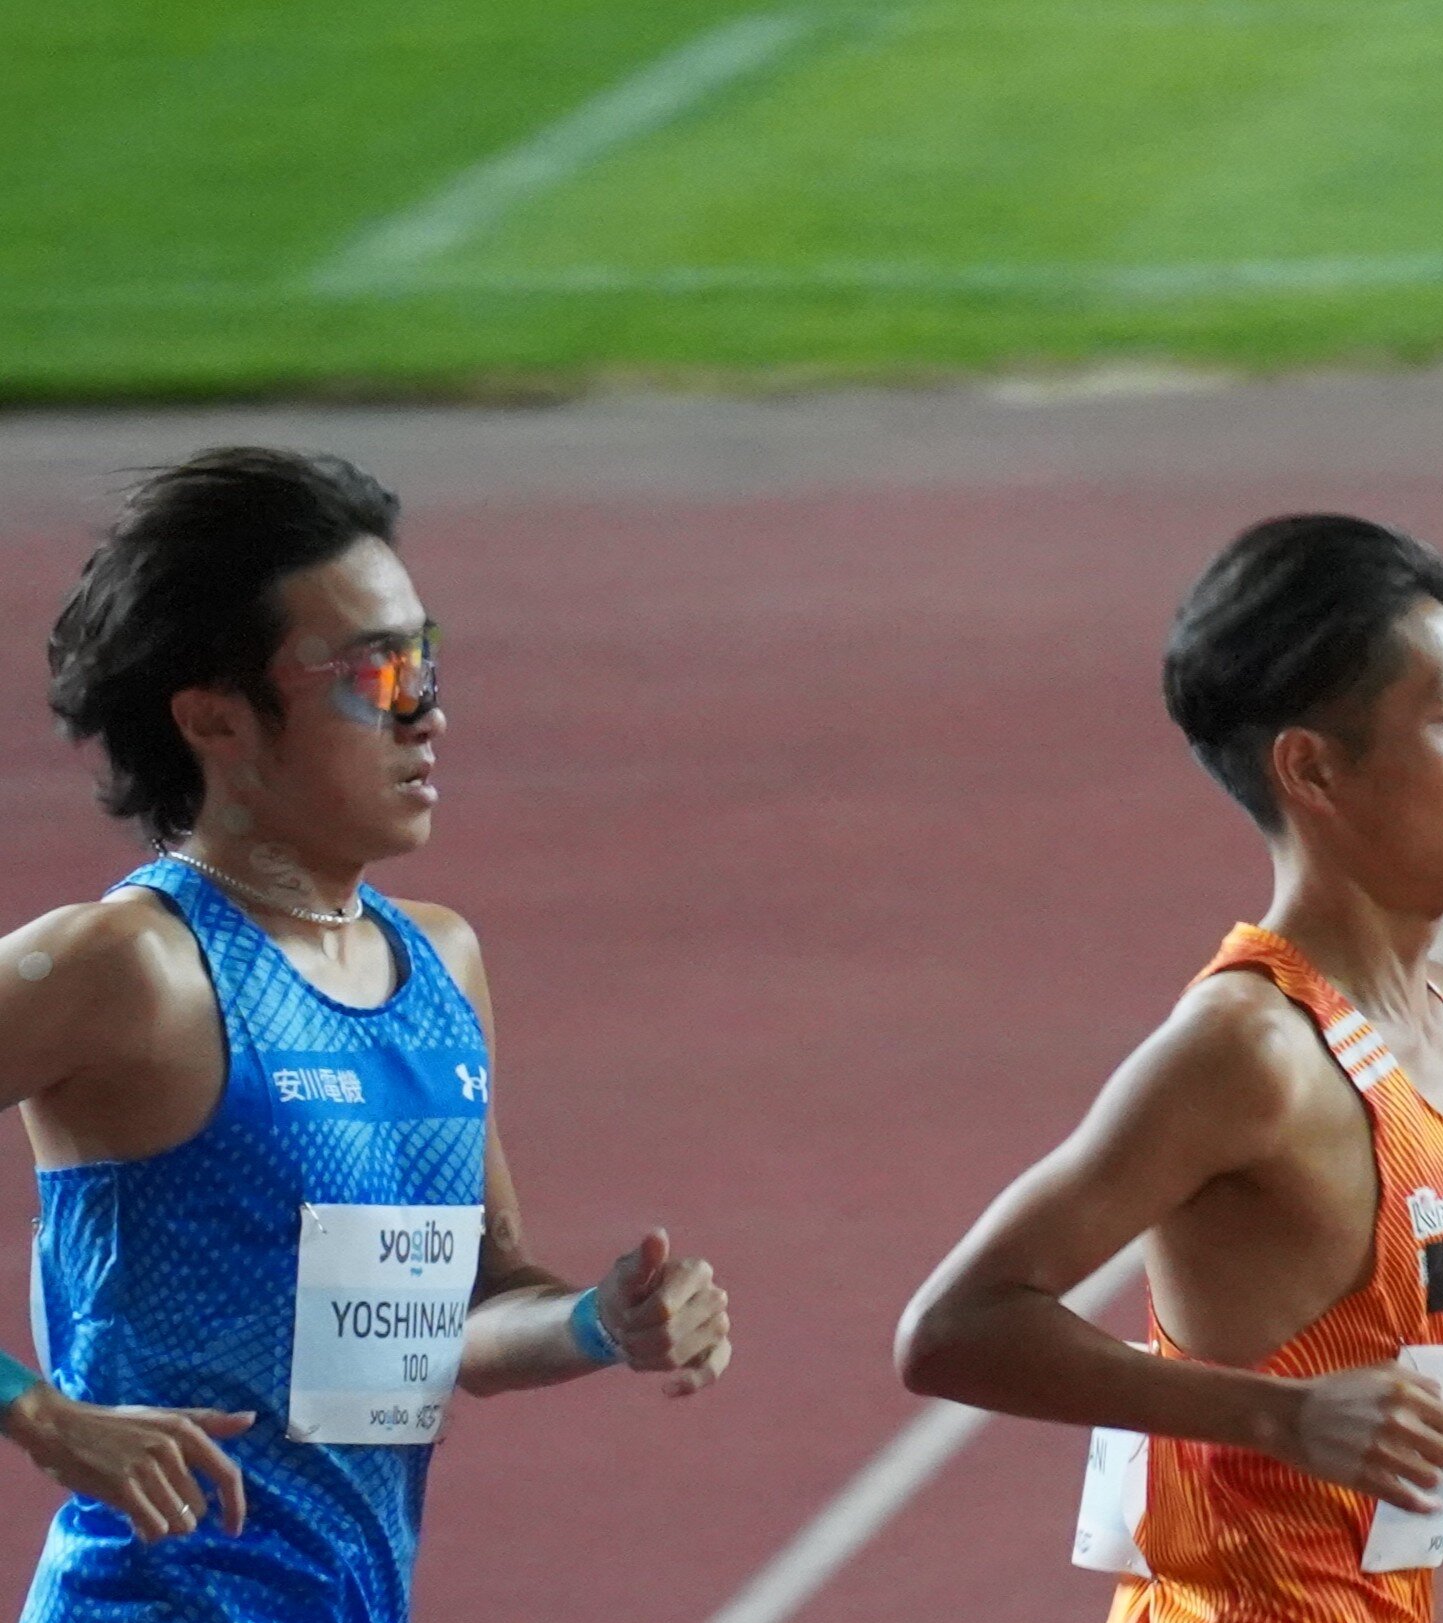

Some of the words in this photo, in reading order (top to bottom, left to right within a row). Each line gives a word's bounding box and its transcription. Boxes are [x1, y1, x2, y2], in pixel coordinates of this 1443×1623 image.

[272, 1067, 366, 1104] 安川電機
[379, 1220, 454, 1276] yogibo
[402, 1353, 429, 1383] 100
